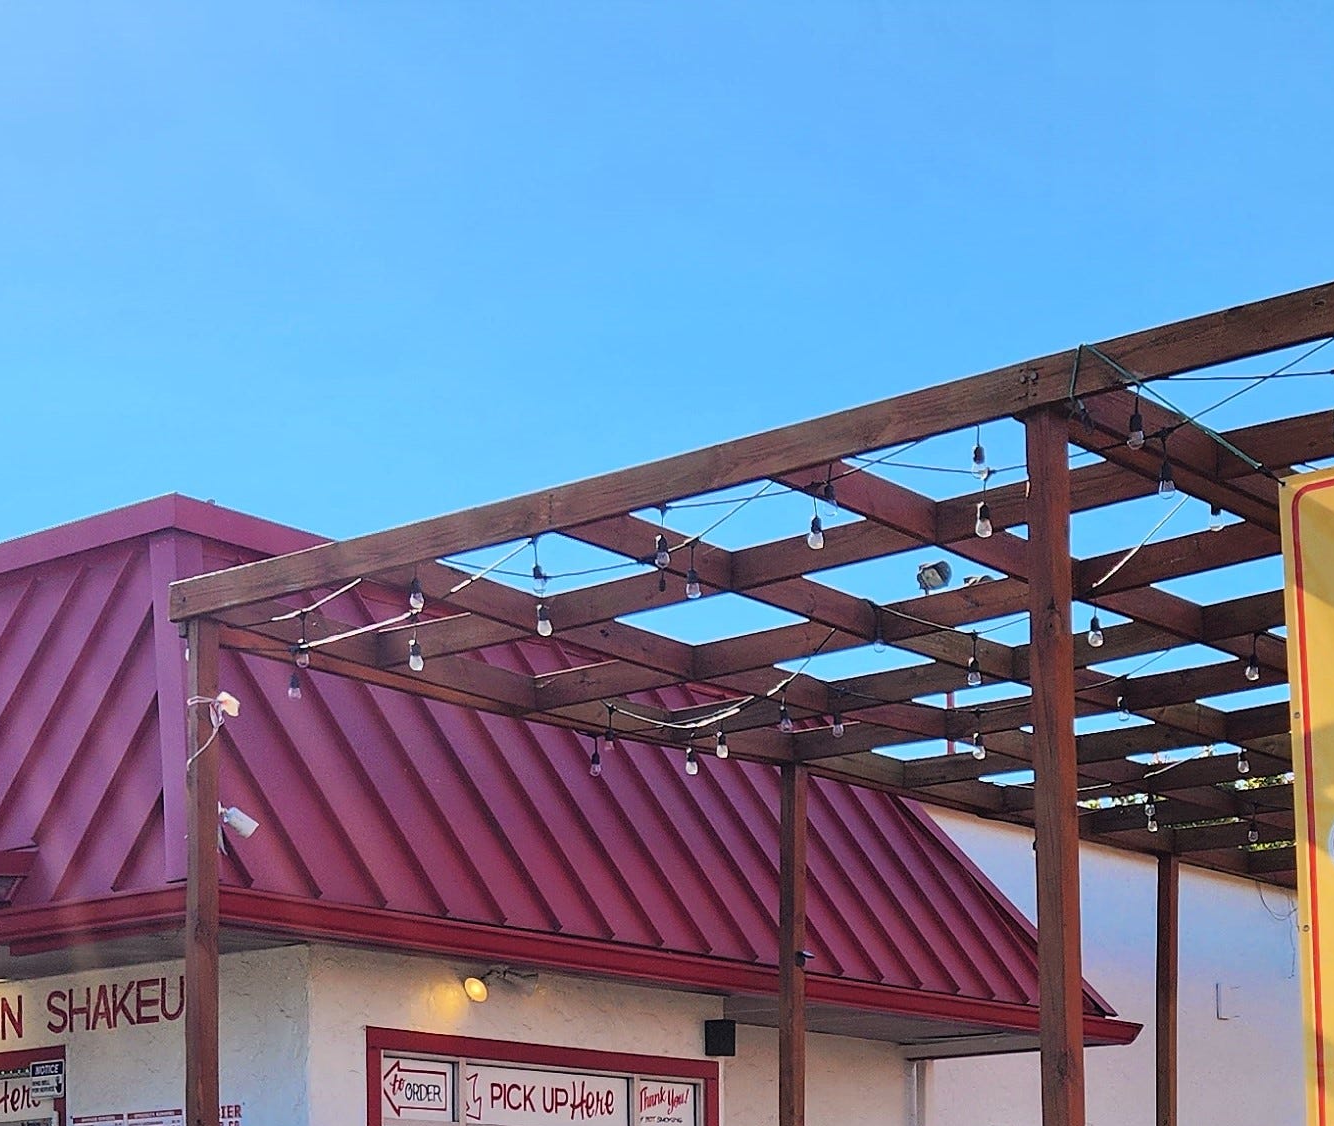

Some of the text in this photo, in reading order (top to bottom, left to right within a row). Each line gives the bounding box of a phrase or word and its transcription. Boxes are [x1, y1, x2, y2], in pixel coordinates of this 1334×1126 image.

[47, 975, 185, 1035] SHAKEU
[34, 1063, 60, 1076] NOTICE
[390, 1073, 442, 1103] to ORDER
[490, 1080, 615, 1120] PICK UP Here
[640, 1086, 690, 1115] Thank You!
